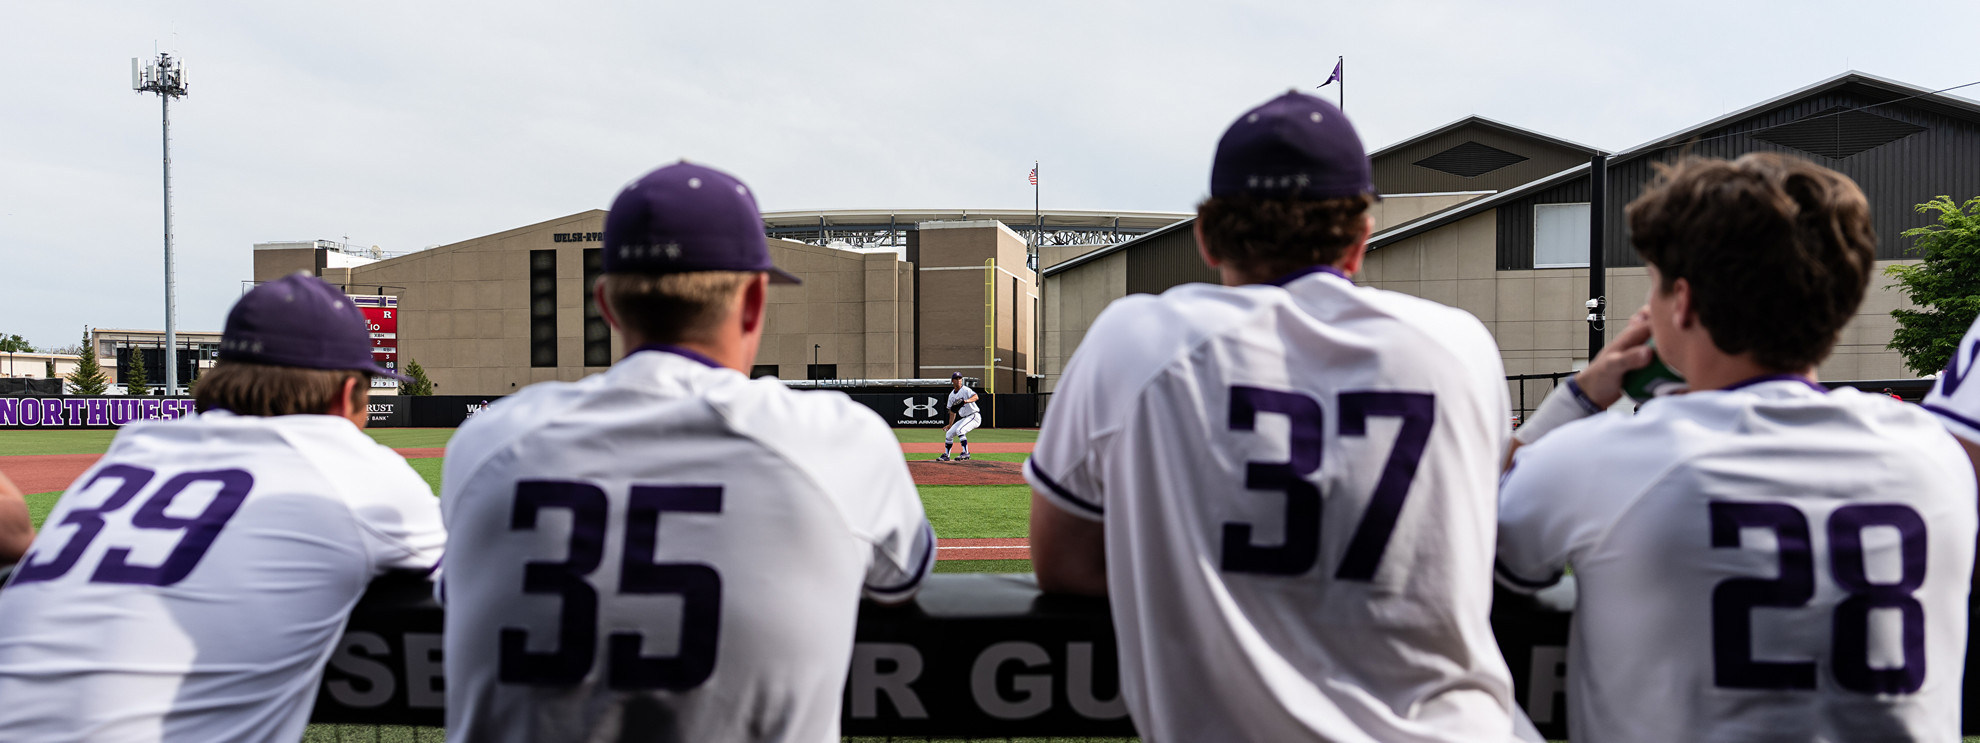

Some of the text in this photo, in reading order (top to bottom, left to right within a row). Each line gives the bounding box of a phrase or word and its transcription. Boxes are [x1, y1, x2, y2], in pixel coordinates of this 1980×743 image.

[10, 464, 254, 586] 39
[1221, 385, 1435, 580] 37
[499, 479, 724, 689] 35
[1709, 502, 1927, 695] 28
